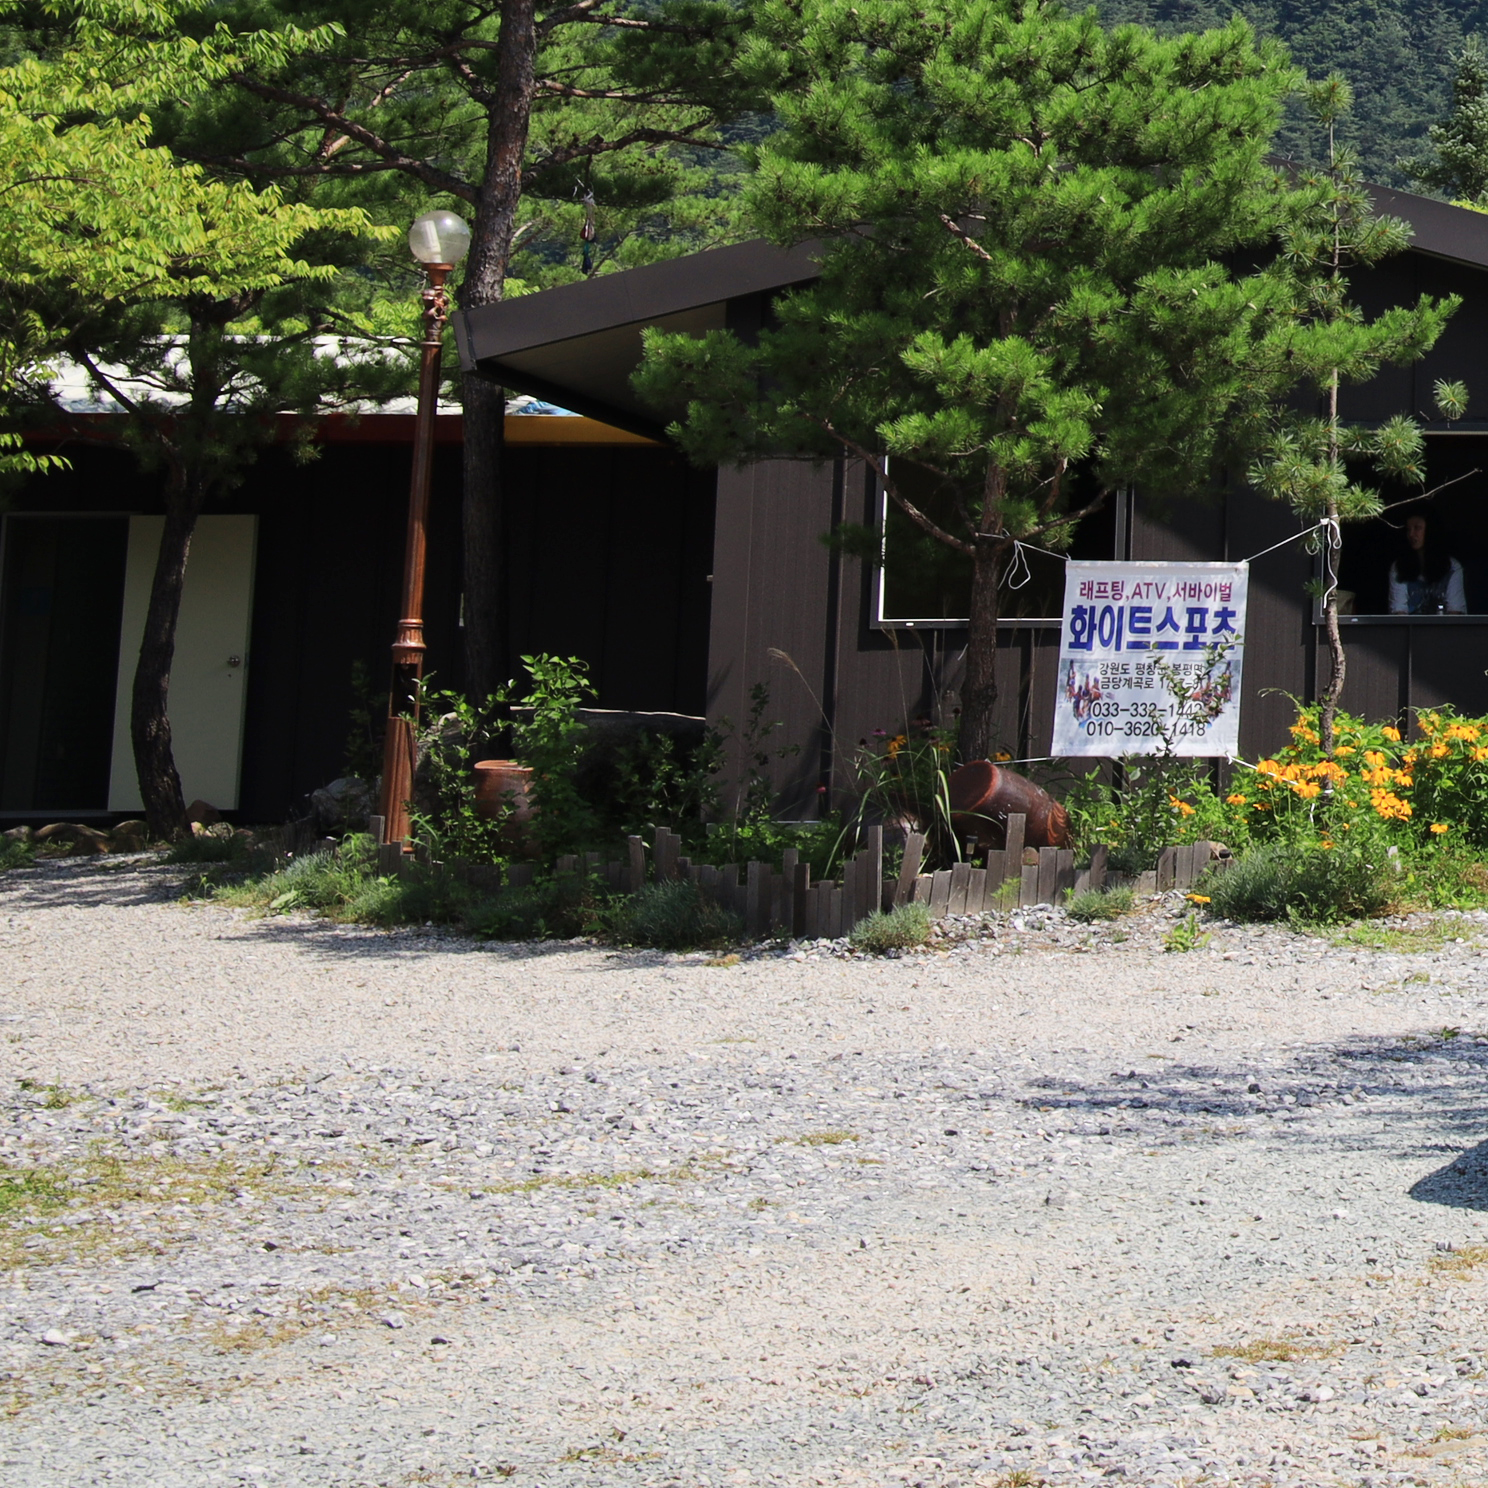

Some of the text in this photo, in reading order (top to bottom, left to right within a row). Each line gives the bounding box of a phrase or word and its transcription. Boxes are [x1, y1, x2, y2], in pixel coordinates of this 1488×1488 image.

[1079, 579, 1233, 603] 래프팅,ATV,서바이벌
[1068, 604, 1237, 652] 화이트스포츠
[1100, 662, 1130, 676] 강원도
[1101, 676, 1154, 690] 금당계곡로
[1087, 721, 1206, 737] 010-3620-1418
